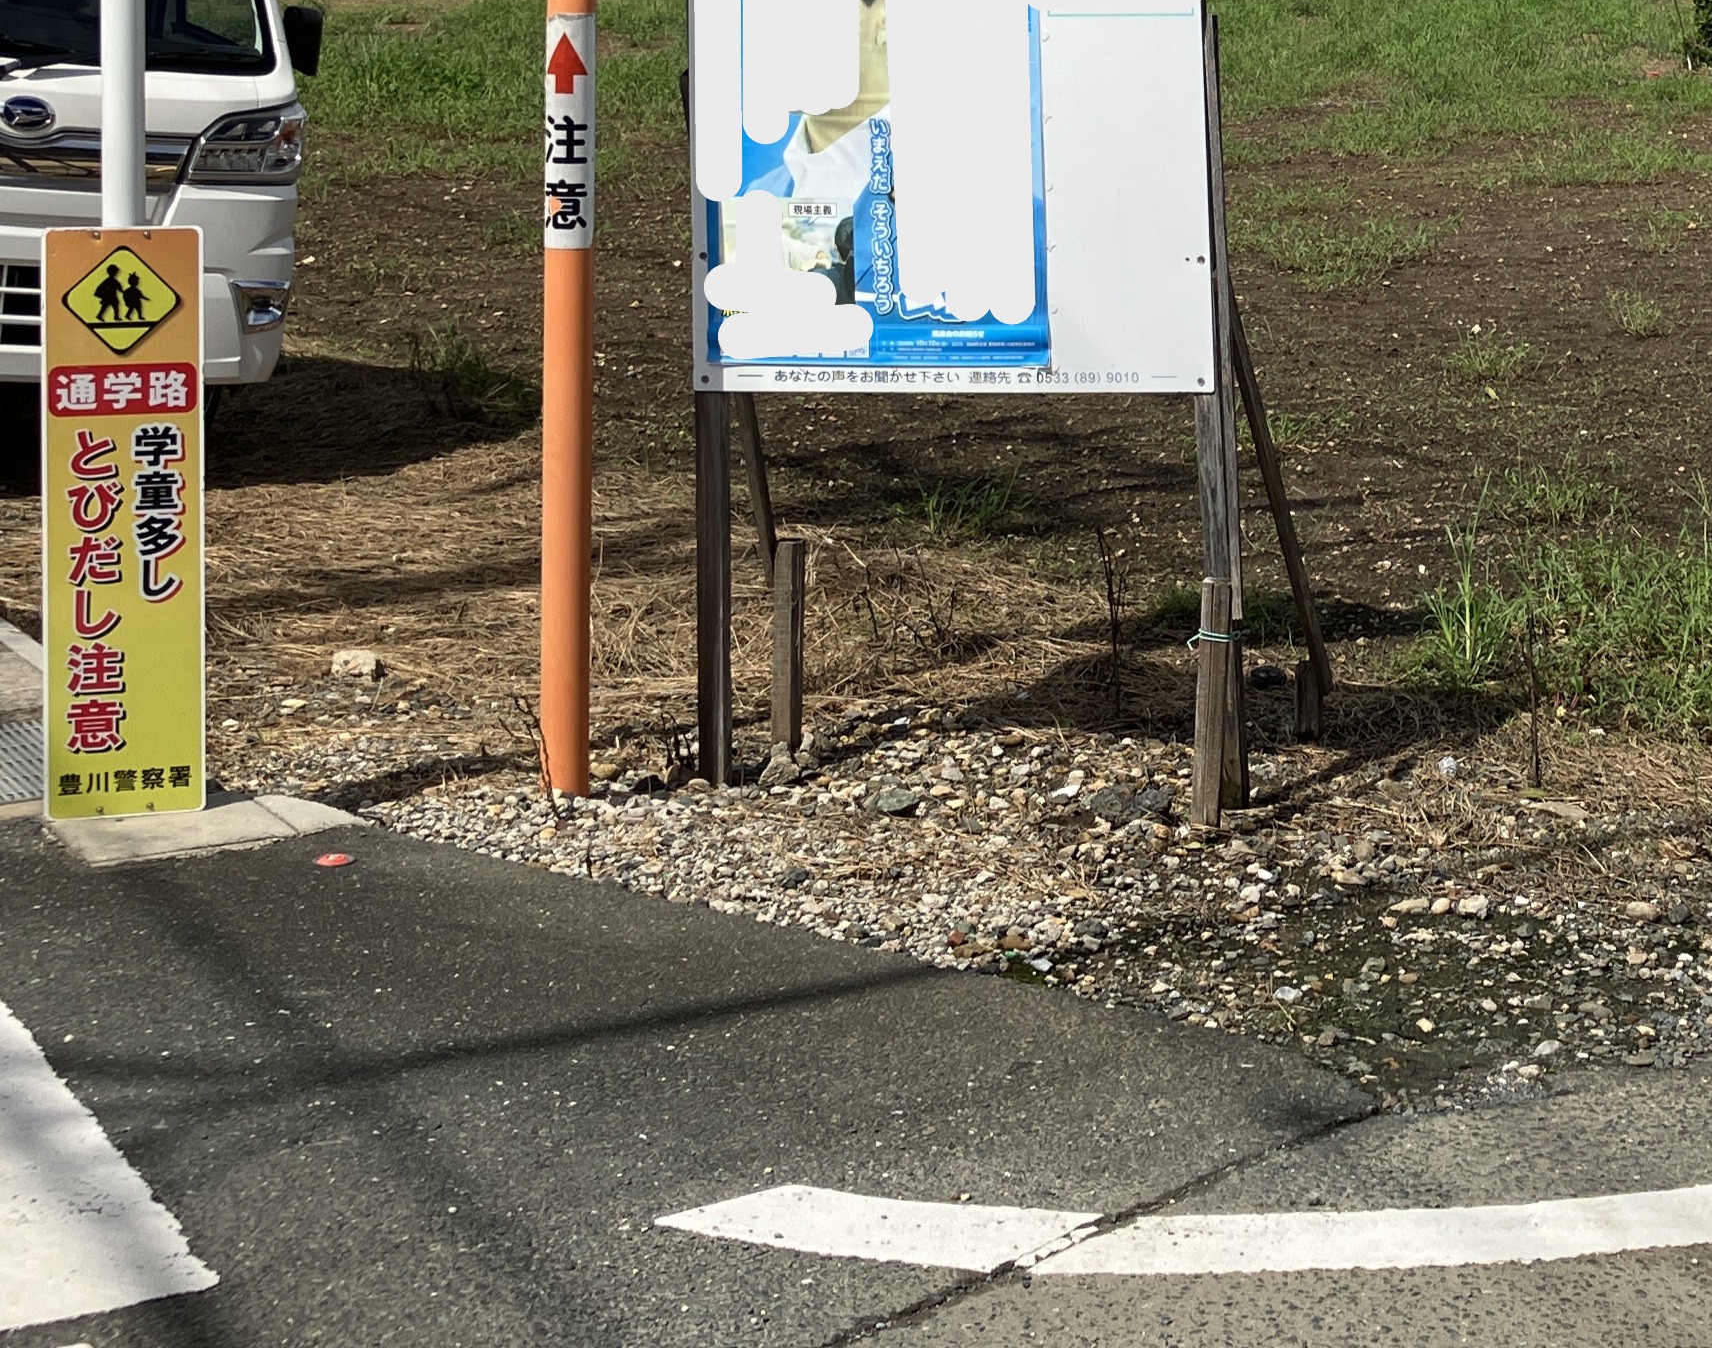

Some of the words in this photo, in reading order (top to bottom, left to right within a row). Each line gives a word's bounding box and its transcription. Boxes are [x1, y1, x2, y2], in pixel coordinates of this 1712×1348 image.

[545, 115, 589, 230] 注意
[870, 118, 890, 194] いまえだ
[872, 203, 893, 314] そういちろう
[56, 370, 189, 411] 通学路
[774, 369, 960, 384] あなたの声をお聞かせ下さい
[968, 371, 1012, 385] 連絡先
[1036, 371, 1069, 384] 0533
[1074, 371, 1101, 385] (89)
[1106, 371, 1140, 384] 9010
[132, 424, 182, 600] 学童多し
[67, 429, 124, 752] とびだし注意
[58, 765, 192, 797] 豊川警察署
